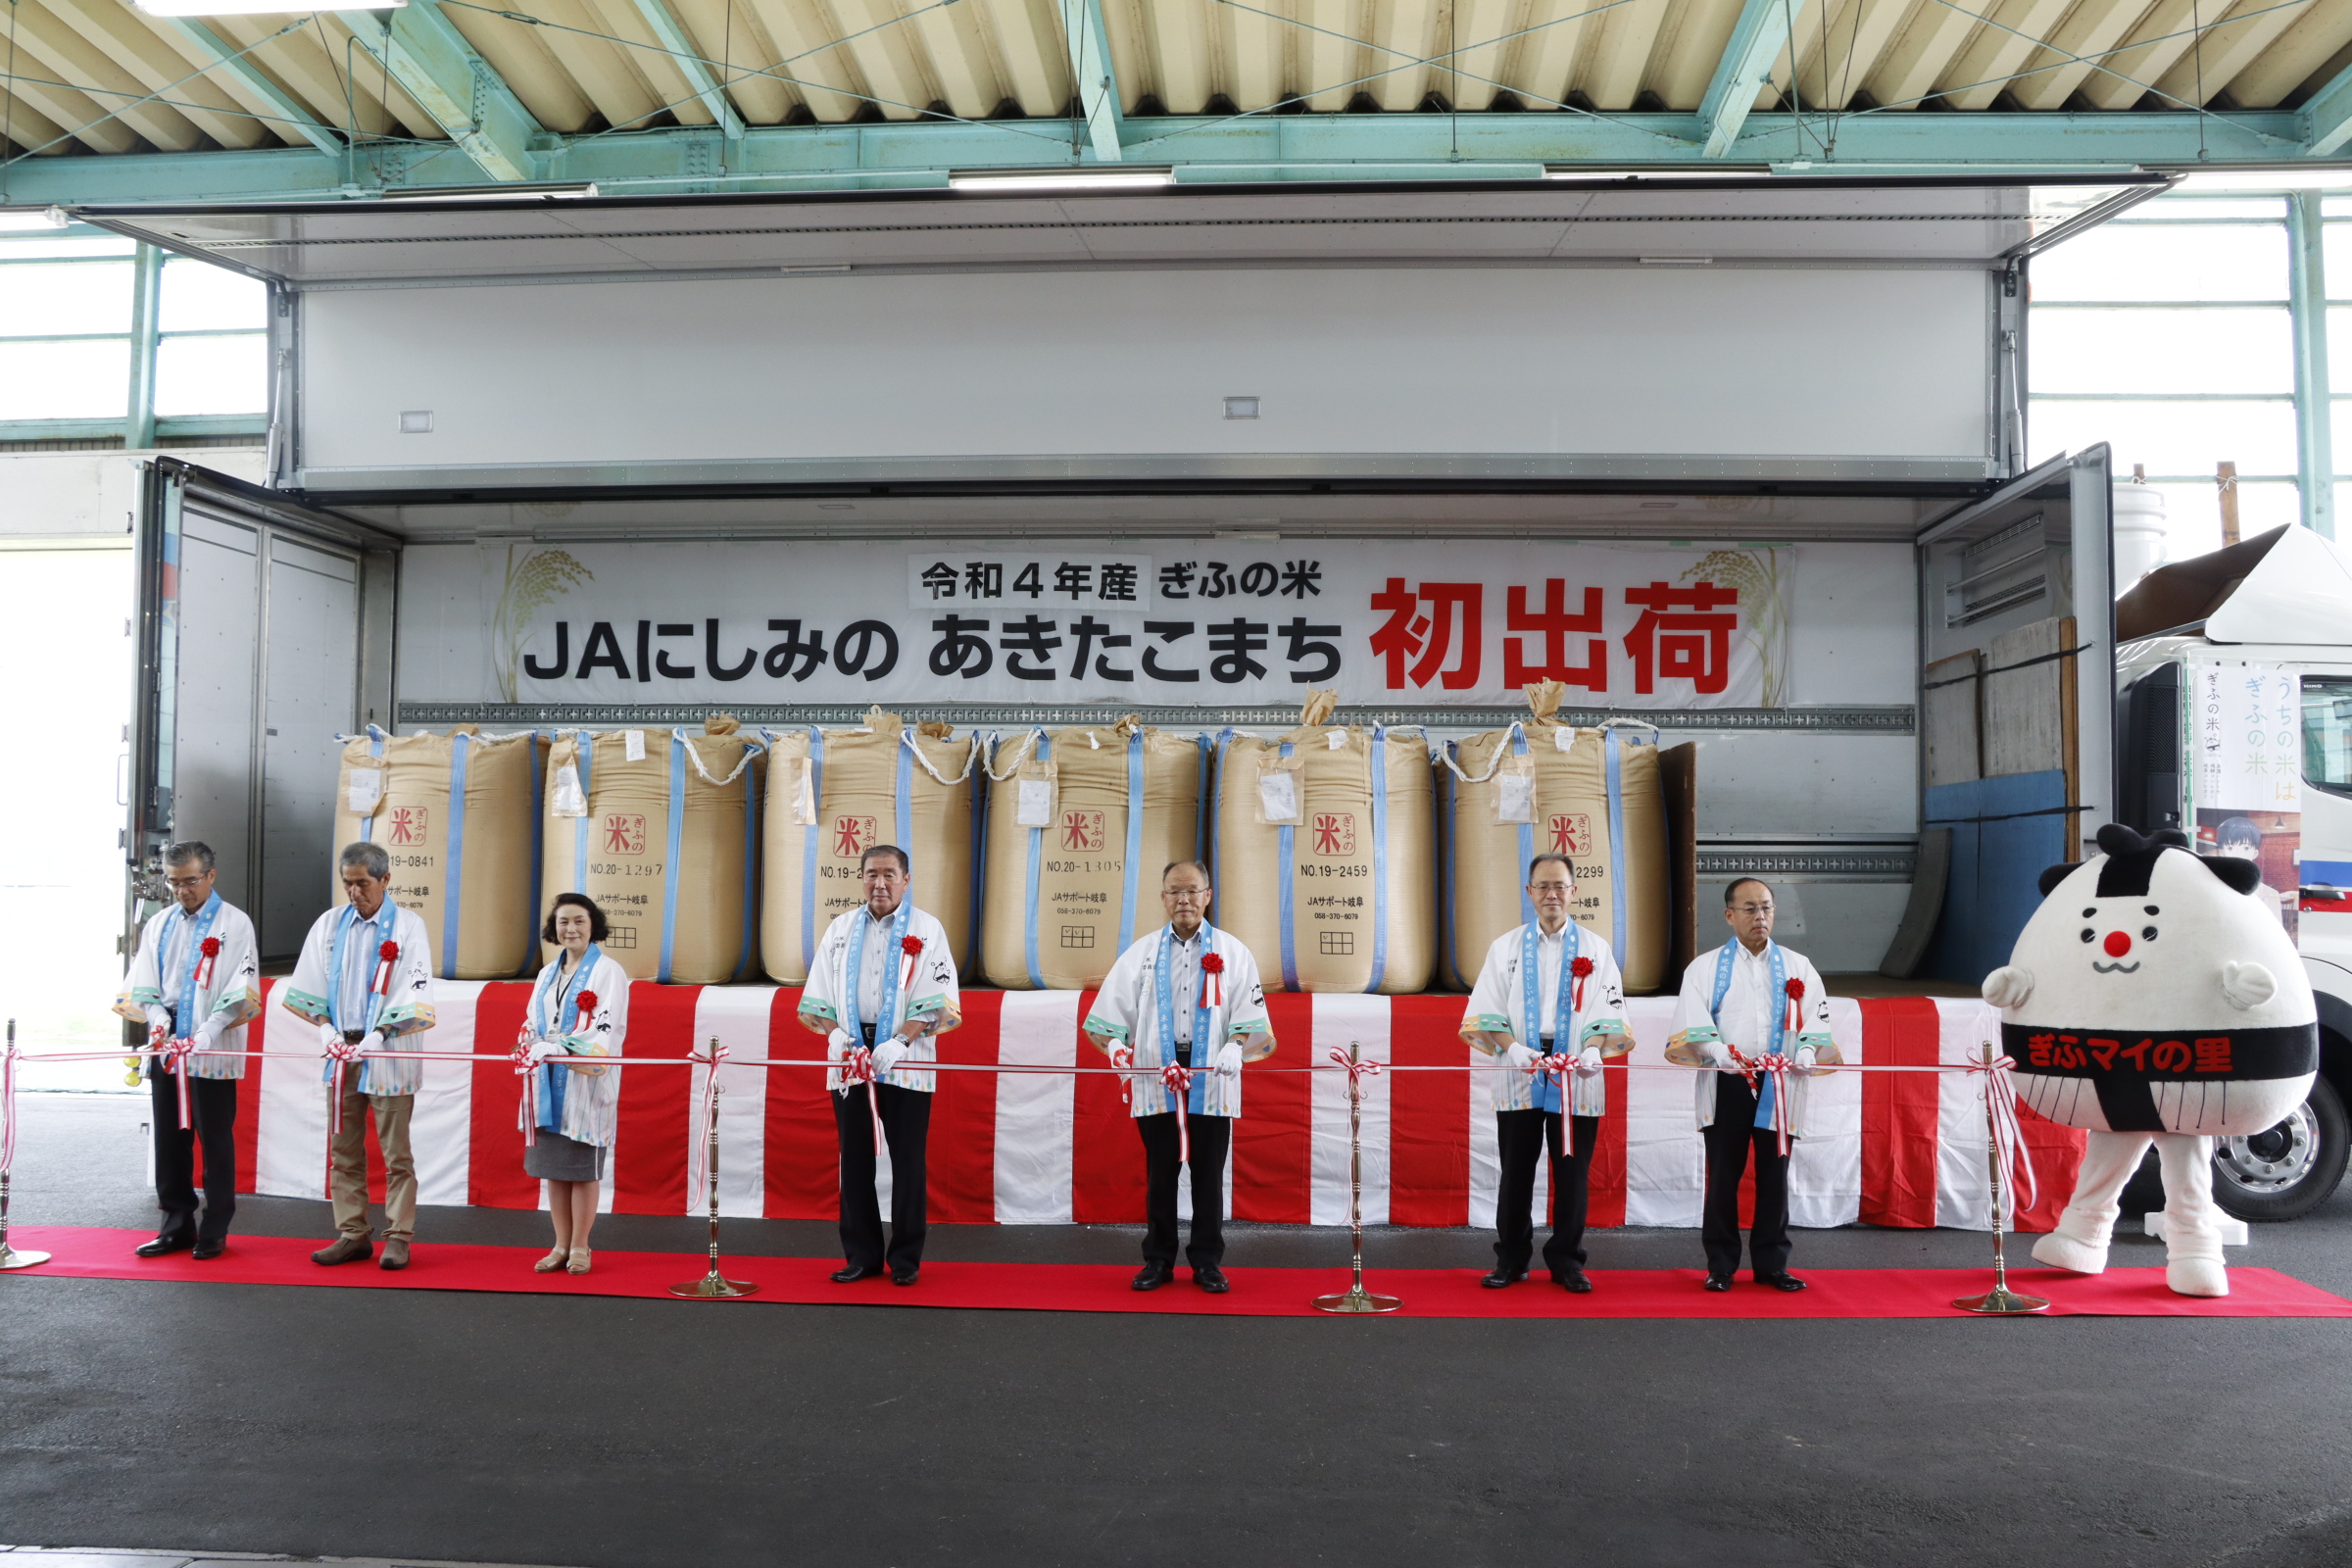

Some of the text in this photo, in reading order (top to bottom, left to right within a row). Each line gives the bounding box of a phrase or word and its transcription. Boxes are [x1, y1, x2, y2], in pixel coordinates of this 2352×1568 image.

[920, 559, 1322, 602] 令和4年産 ぎふの米
[523, 613, 1343, 685] JAにしみの あきたこまち
[1369, 577, 1738, 695] 初出荷
[2205, 671, 2221, 732] ぎふの米
[2244, 674, 2269, 776] ぎふの米
[2274, 675, 2296, 802] うちの米は
[389, 808, 426, 844] ぎふの 米
[606, 815, 644, 853] ぎふの 米
[835, 817, 860, 856] 米
[1063, 811, 1103, 850] ぎふの 米
[1315, 815, 1354, 854] ぎふの 米
[1550, 815, 1590, 855] ぎふの 米
[1300, 864, 1368, 878] NO.19-2459
[595, 894, 649, 905] JAサポート岐阜
[1051, 892, 1107, 904] JAサポート岐阜
[1307, 896, 1364, 907] JAサポート岐阜
[2028, 1033, 2234, 1073] ぎふマイの里
